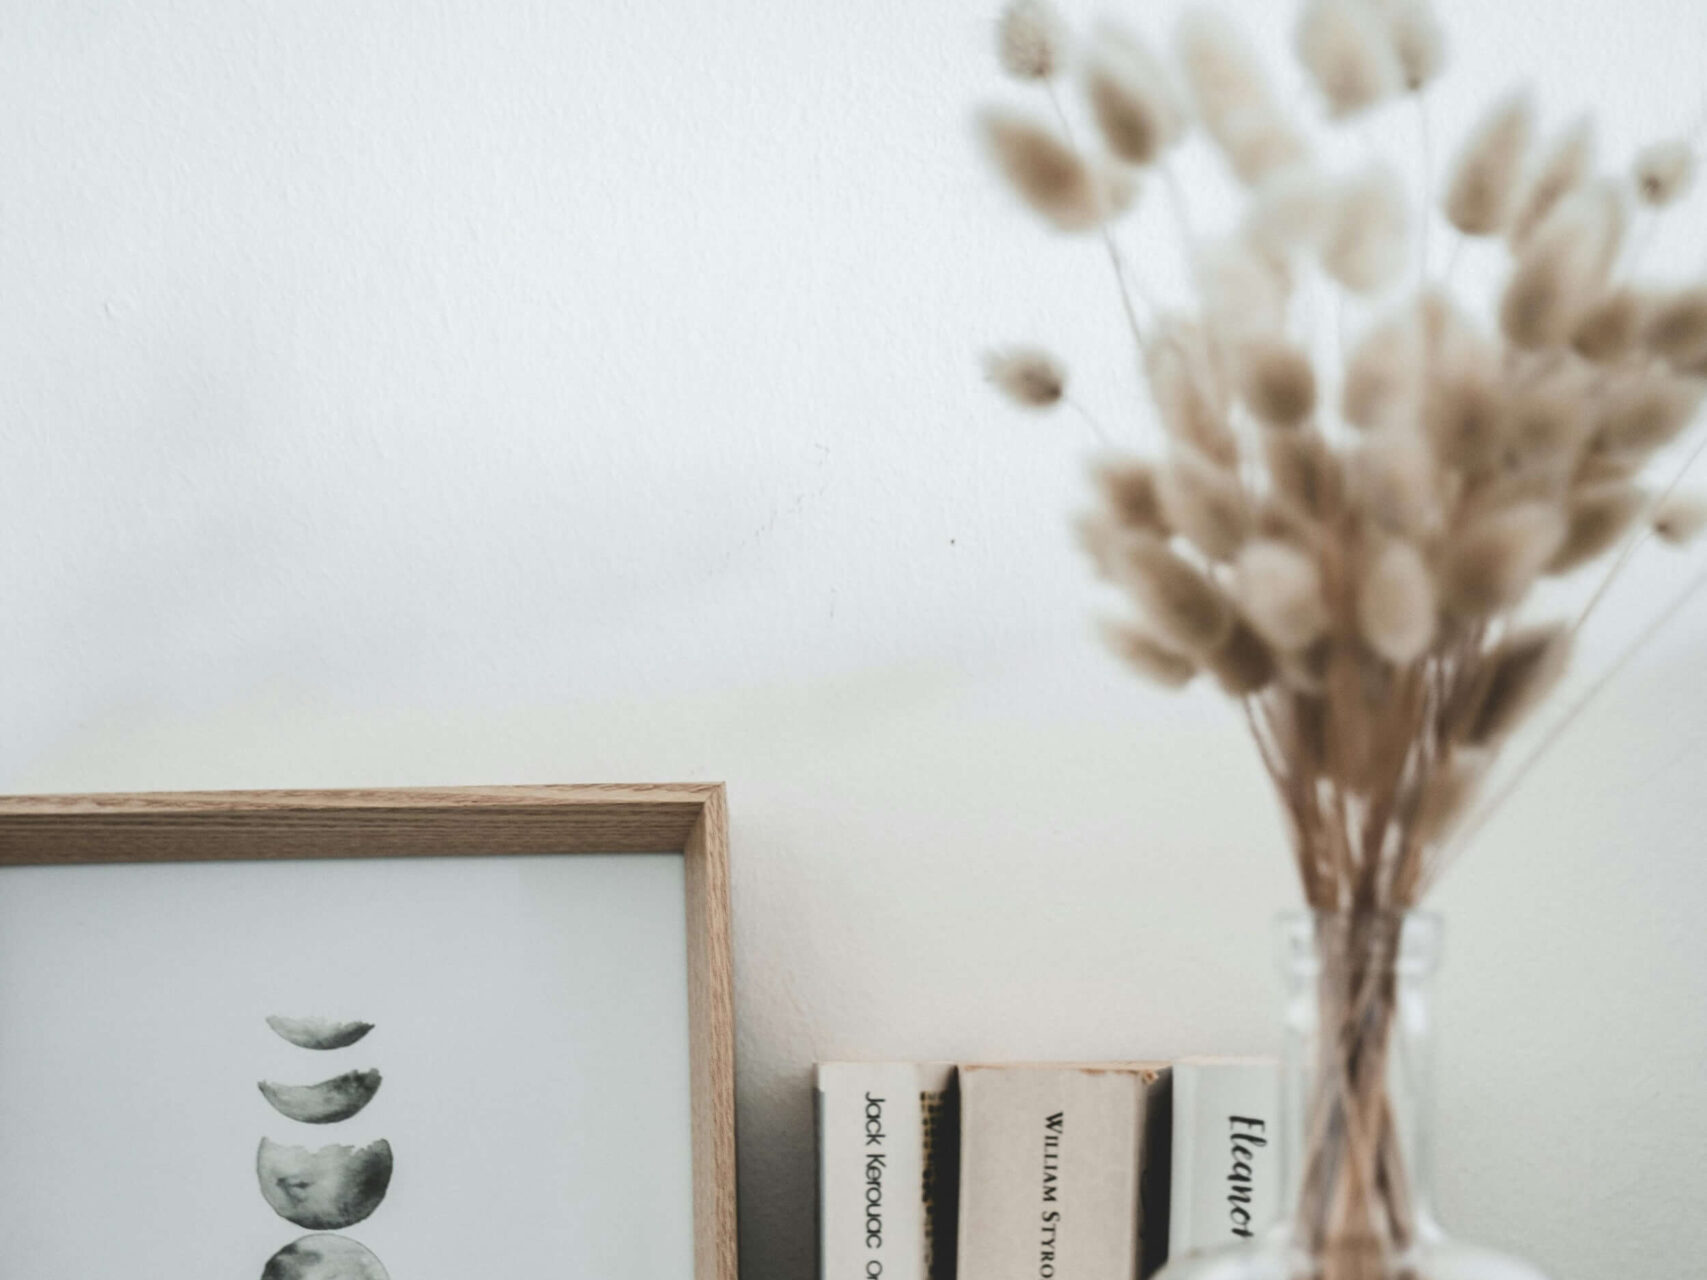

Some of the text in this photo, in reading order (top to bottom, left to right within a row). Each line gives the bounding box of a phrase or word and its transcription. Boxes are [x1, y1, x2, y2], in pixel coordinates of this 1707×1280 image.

[864, 1091, 886, 1146] Jack
[1042, 1111, 1064, 1202] WILLIAM
[865, 1154, 887, 1249] Kerouac
